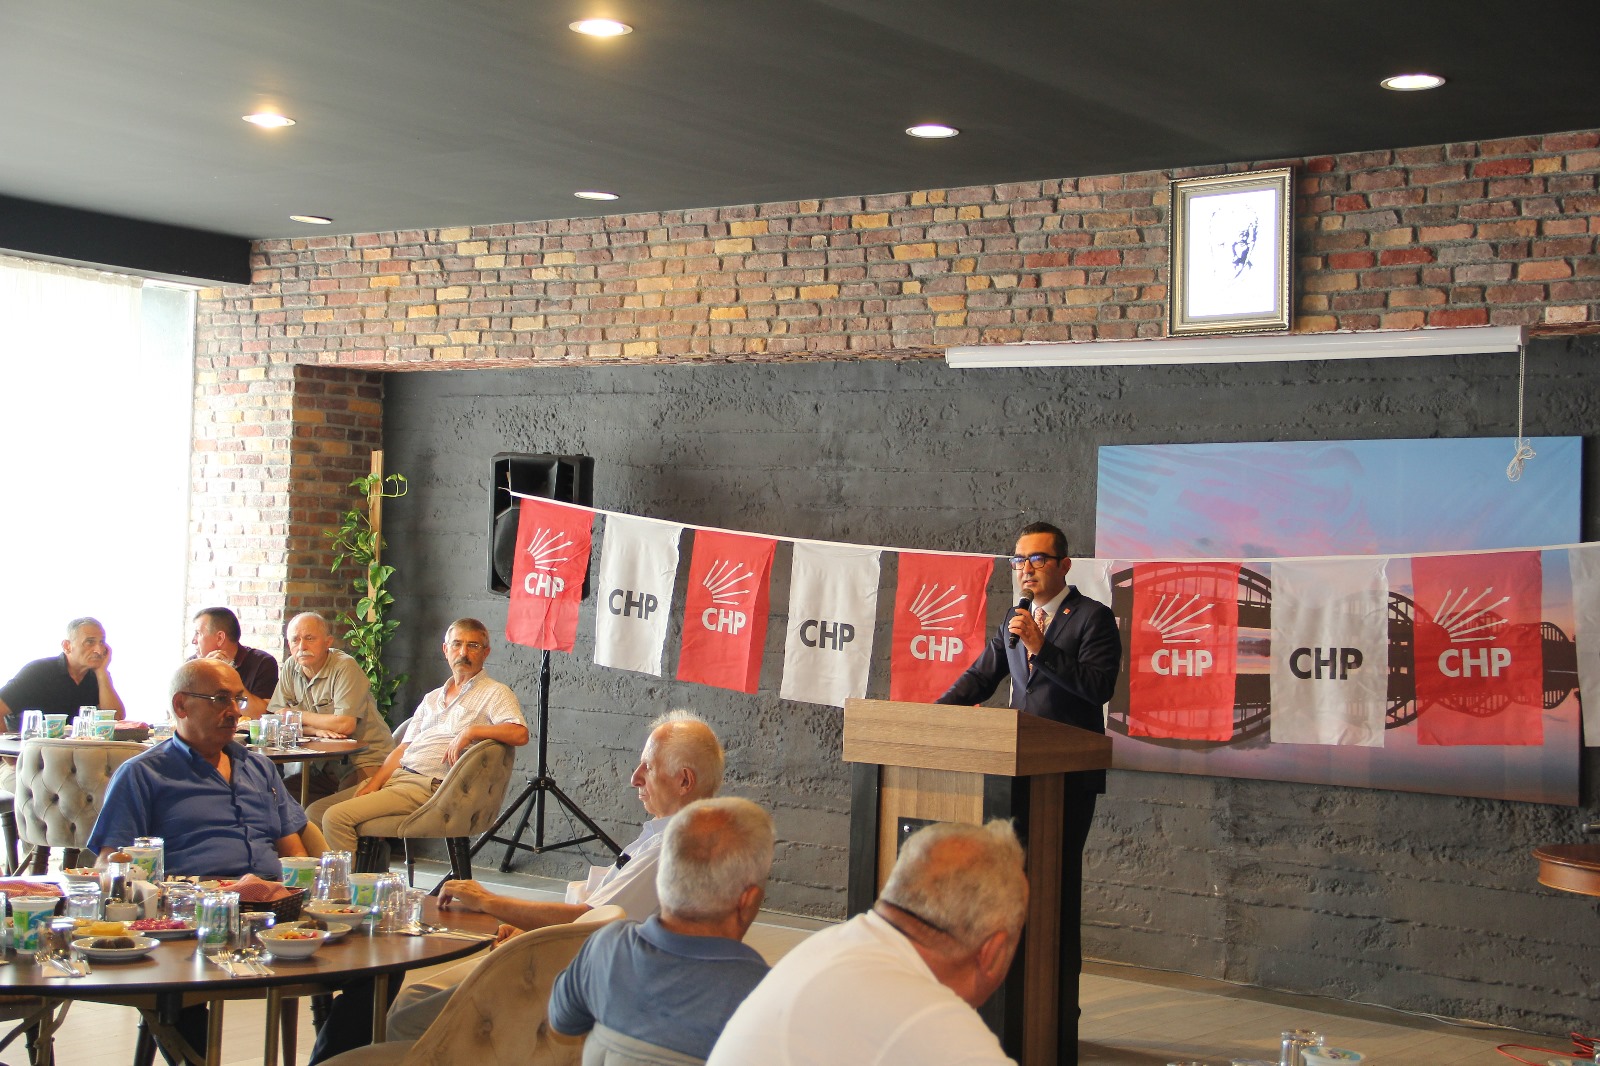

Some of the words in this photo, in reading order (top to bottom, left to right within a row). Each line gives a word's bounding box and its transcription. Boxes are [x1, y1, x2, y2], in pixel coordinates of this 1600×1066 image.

[524, 572, 565, 598] CHP
[608, 588, 658, 620] CHP
[701, 607, 747, 635] CHP
[799, 619, 855, 651] CHP
[910, 634, 963, 662] CHP
[1438, 647, 1512, 677] CHP
[1151, 649, 1213, 677] CHP
[1289, 647, 1364, 680] CHP
